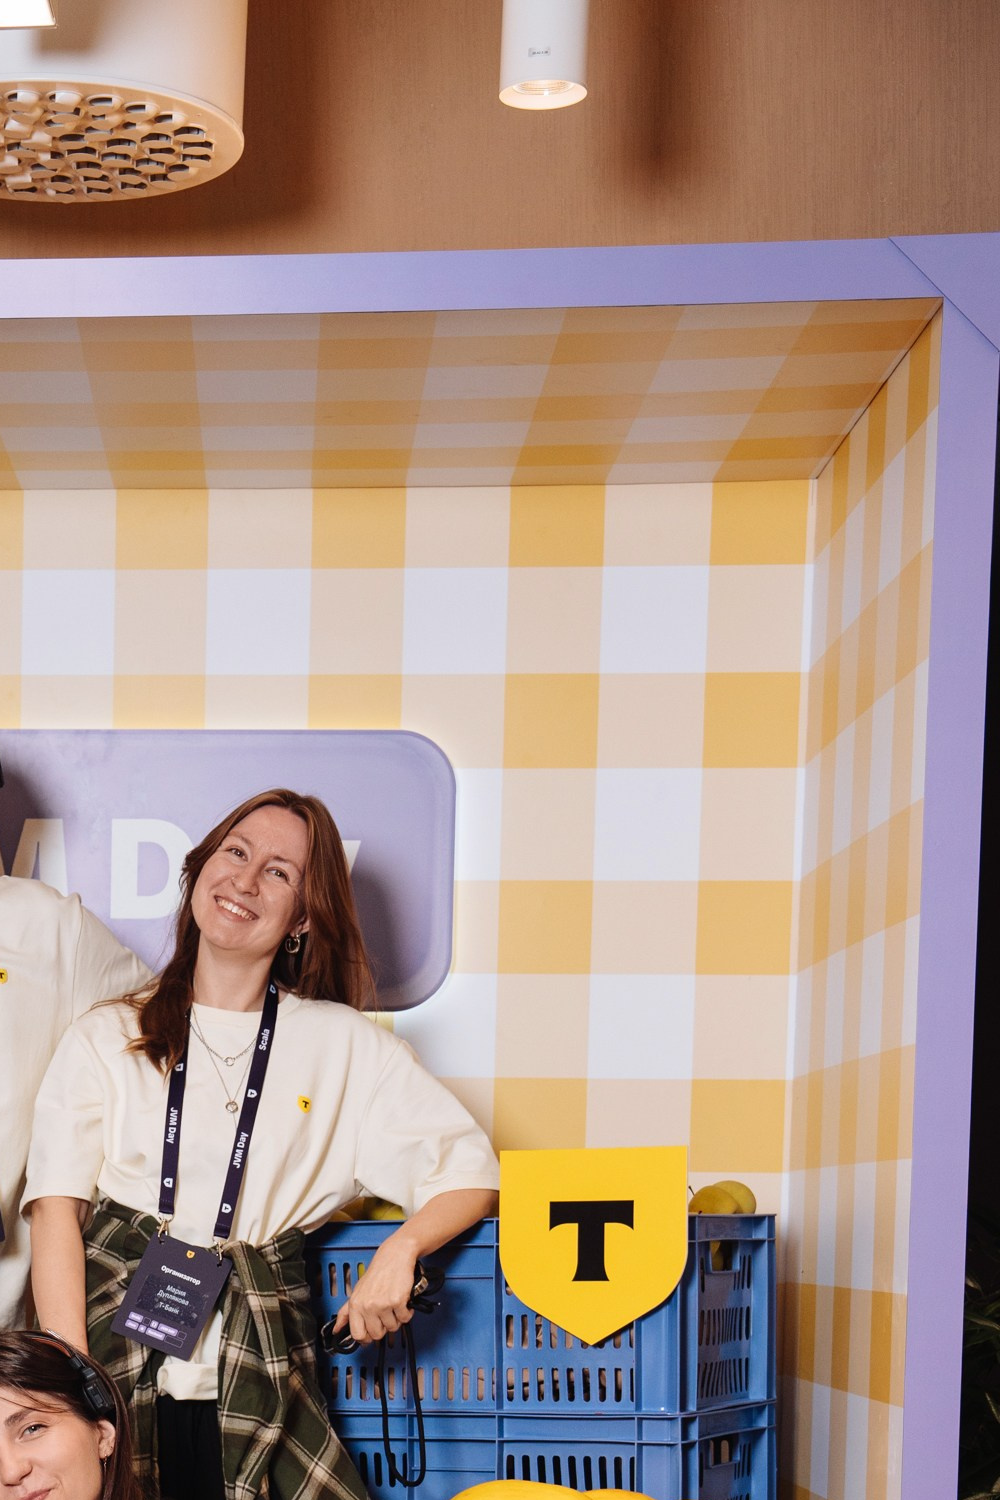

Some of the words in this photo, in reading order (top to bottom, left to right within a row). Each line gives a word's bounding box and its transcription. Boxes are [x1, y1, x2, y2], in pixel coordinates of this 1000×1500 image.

[258, 1028, 270, 1051] Scala
[168, 1107, 179, 1126] JVM
[165, 1127, 177, 1144] Day
[236, 1131, 249, 1148] Day
[232, 1148, 244, 1169] JVM
[549, 1200, 634, 1282] T
[160, 1265, 201, 1286] Организатор
[166, 1284, 187, 1298] Мария
[159, 1302, 180, 1315] Т-Банк
